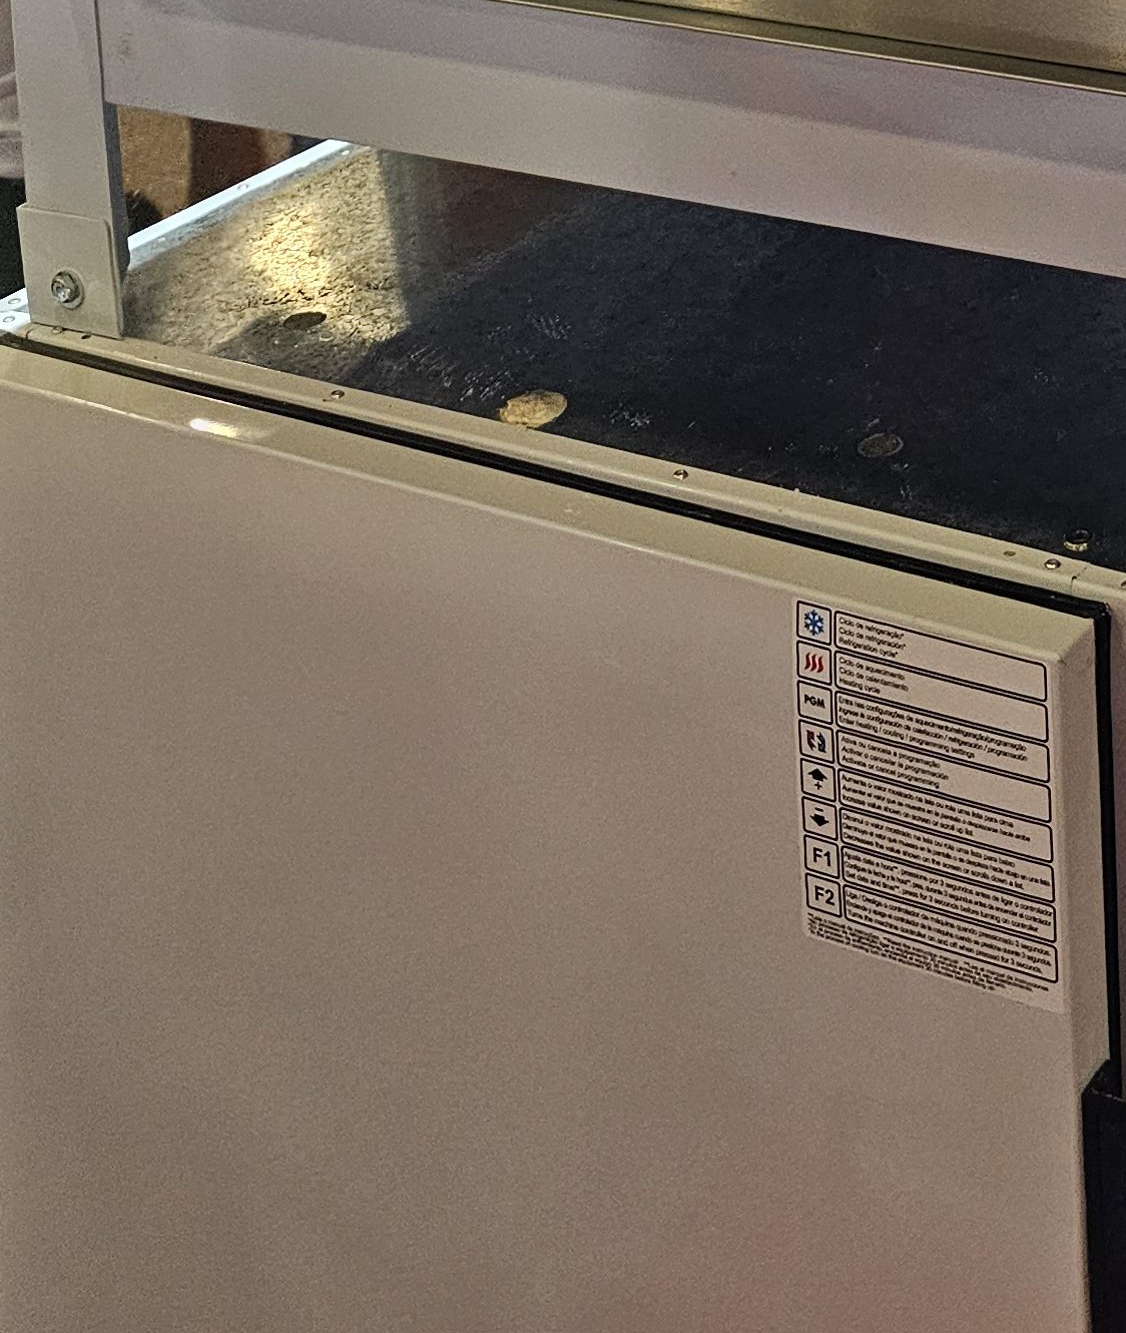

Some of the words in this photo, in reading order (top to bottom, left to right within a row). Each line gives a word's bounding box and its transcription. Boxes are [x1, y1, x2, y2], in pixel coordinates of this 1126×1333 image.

[804, 693, 825, 708] PGM
[812, 847, 831, 867] F1
[814, 885, 835, 906] F2
